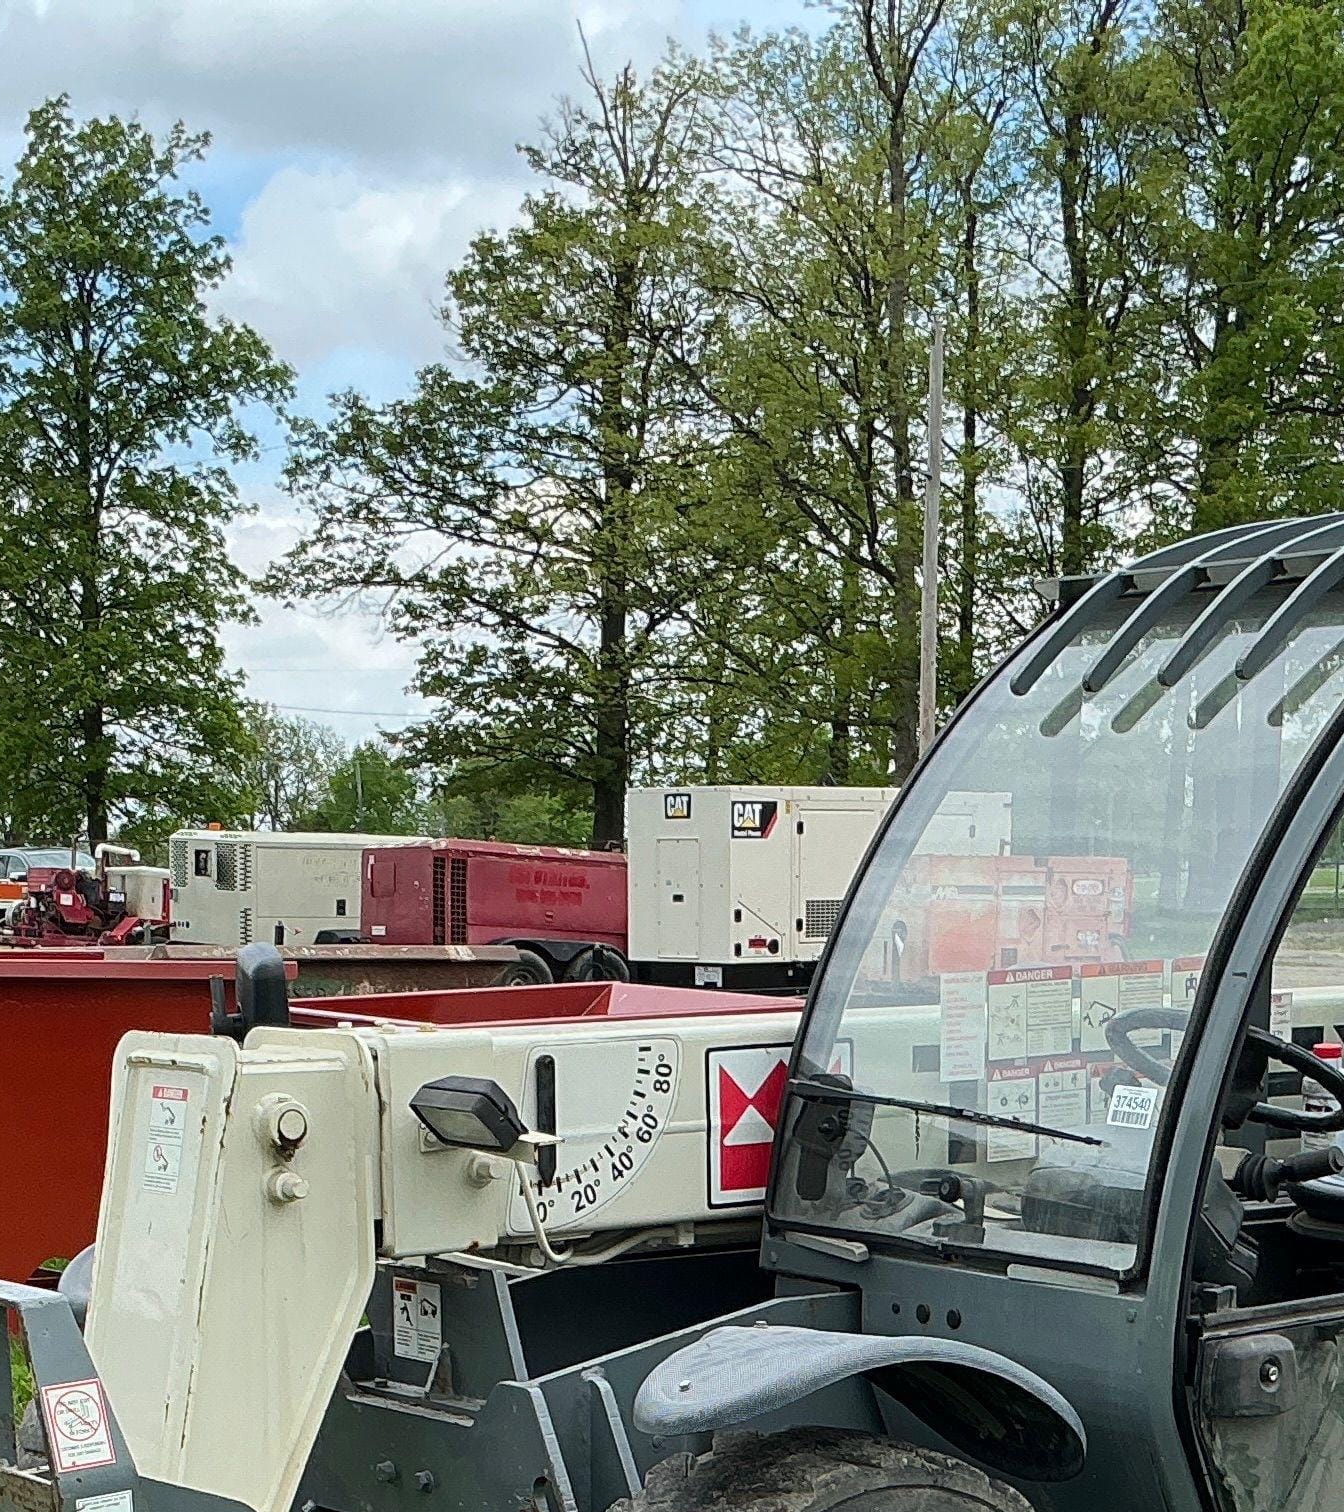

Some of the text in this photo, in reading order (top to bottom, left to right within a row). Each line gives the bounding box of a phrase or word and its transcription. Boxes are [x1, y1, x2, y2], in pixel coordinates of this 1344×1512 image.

[666, 795, 690, 817] CAT
[733, 803, 763, 828] CAT
[1015, 969, 1054, 981] DANGER
[1113, 1094, 1152, 1112] 374540
